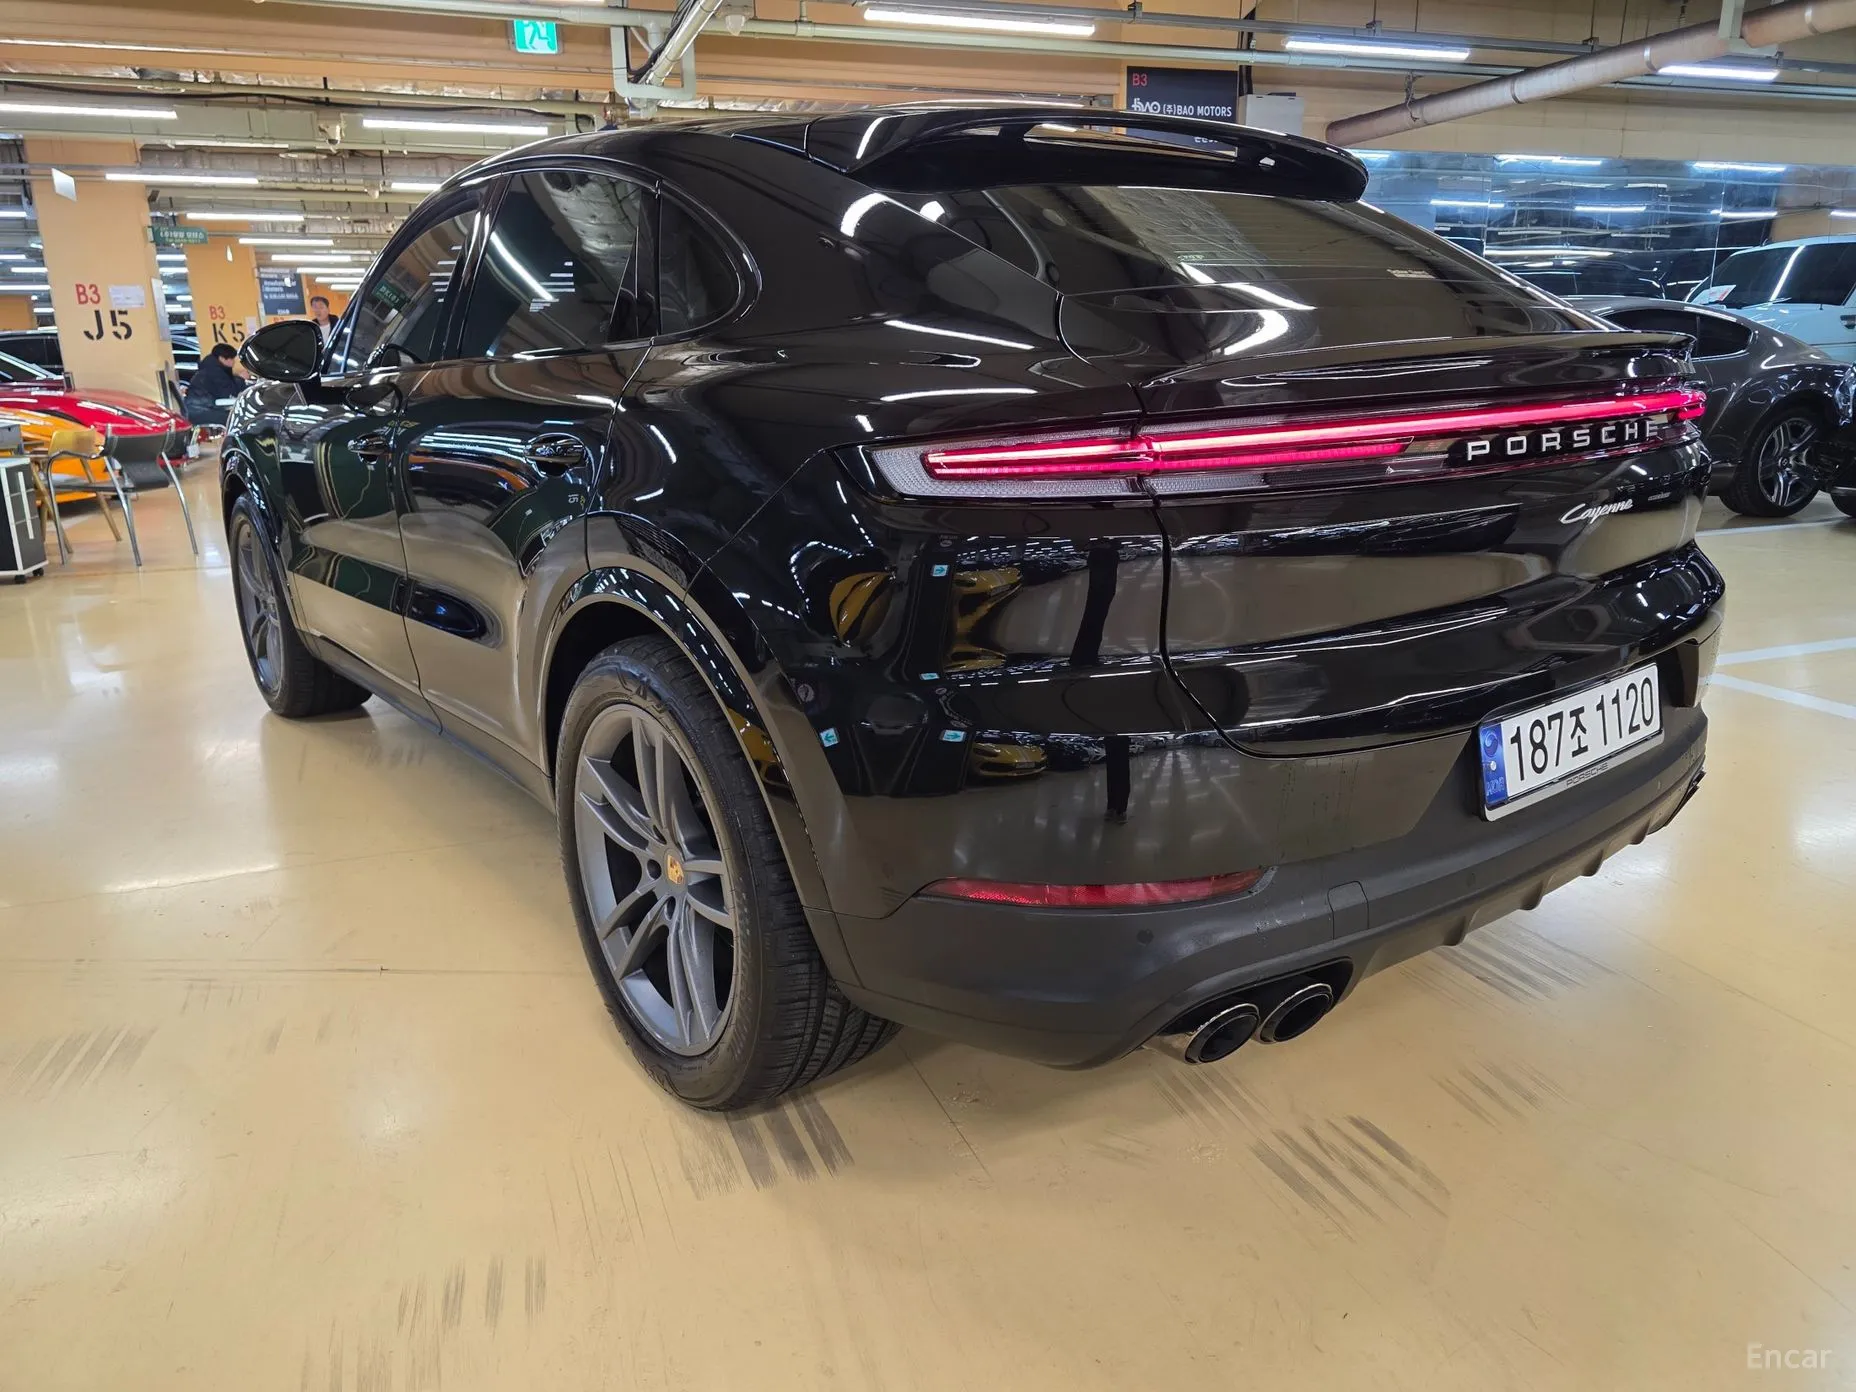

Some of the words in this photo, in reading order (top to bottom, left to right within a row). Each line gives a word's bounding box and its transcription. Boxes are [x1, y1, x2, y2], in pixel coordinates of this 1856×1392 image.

[1132, 73, 1147, 87] B3
[1197, 105, 1232, 117] MOTORS
[75, 283, 101, 305] B3
[84, 310, 132, 341] J5
[209, 305, 226, 320] B3
[1467, 420, 1659, 461] PORSCHE
[1558, 498, 1634, 524] Cayenne
[1510, 705, 1589, 781] 187조
[1596, 677, 1654, 746] 1120
[1566, 762, 1609, 788] PORSCHE
